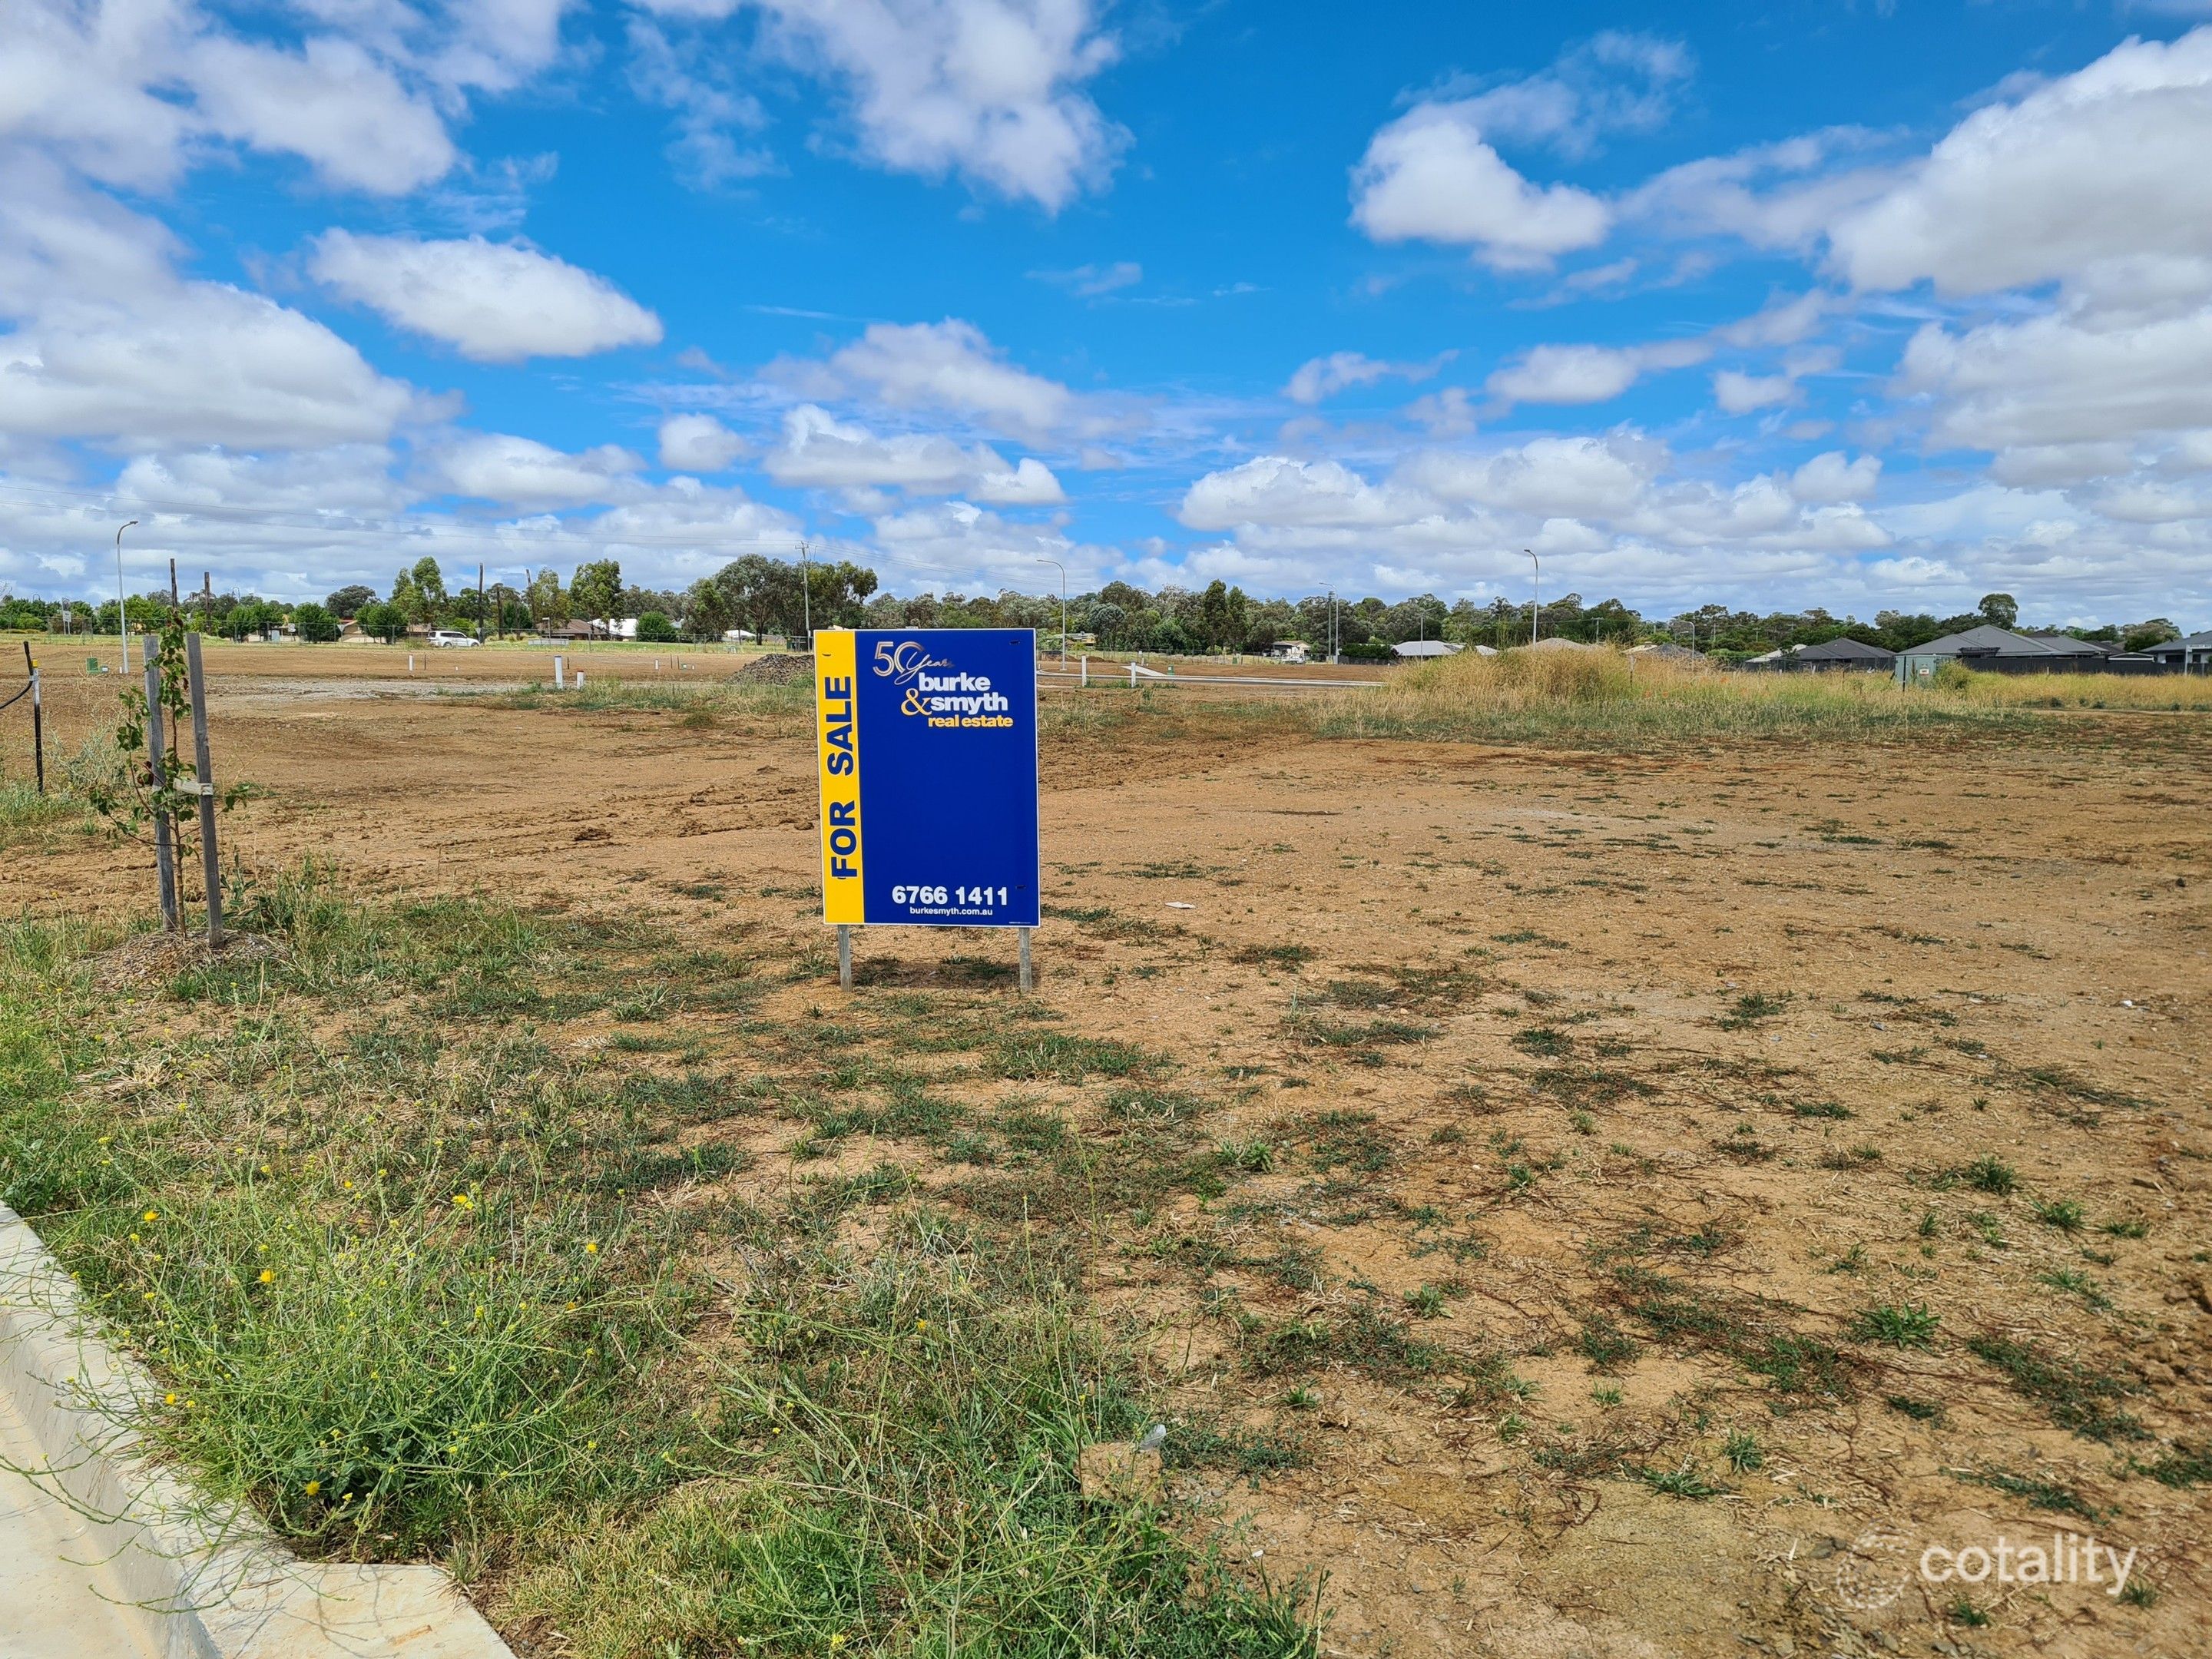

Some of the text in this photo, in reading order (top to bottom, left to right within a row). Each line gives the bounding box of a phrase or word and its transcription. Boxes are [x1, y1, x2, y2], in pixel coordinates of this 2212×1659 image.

[873, 641, 924, 676] 50
[919, 672, 991, 691] burke
[930, 692, 1008, 715] smyth
[928, 714, 1014, 727] real estate
[825, 677, 857, 877] FOR SALE
[892, 886, 1007, 906] 6766 1411
[909, 906, 993, 916] burkesmyth.com.au
